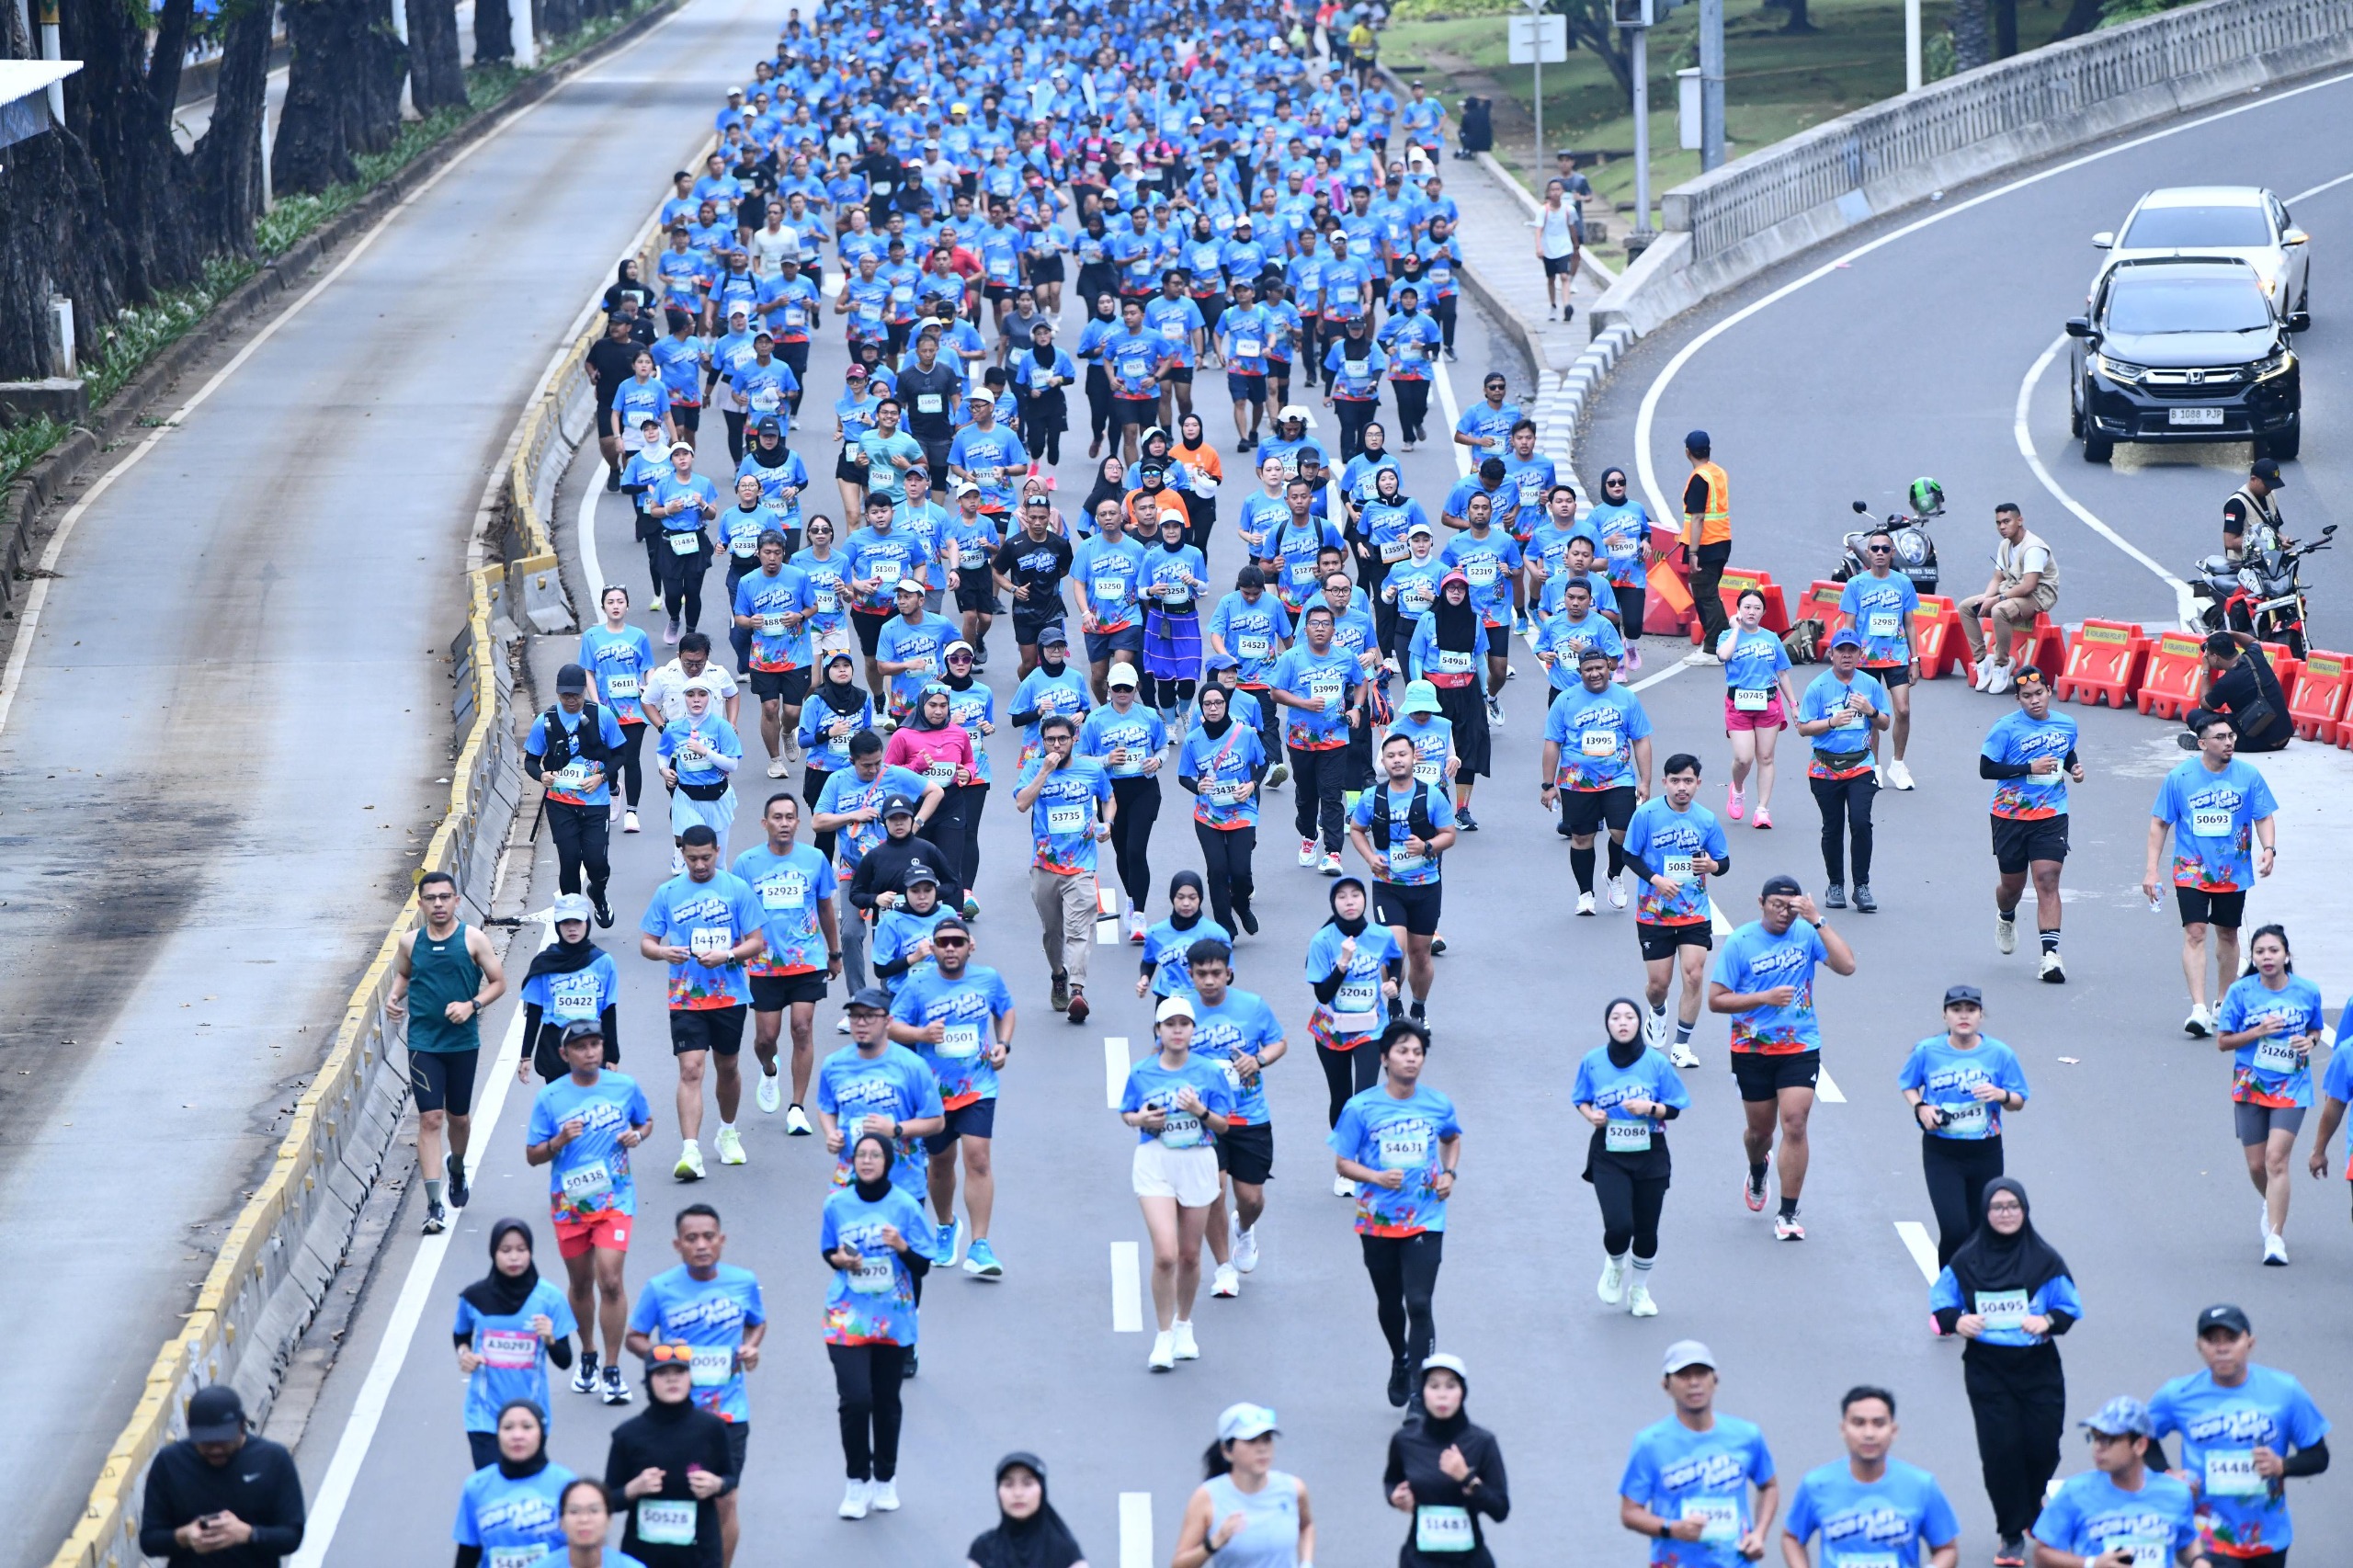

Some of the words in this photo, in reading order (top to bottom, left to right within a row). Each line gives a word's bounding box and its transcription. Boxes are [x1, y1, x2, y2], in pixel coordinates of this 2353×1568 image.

[2171, 409, 2177, 419] B
[2180, 409, 2201, 419] 1088
[2206, 409, 2222, 419] PJP
[1384, 545, 1404, 554] 13559
[874, 564, 897, 573] 51301
[1294, 566, 1313, 574] 5327
[1470, 567, 1492, 575] 52319
[1872, 618, 1896, 626] 52987
[1241, 641, 1266, 649] 54523
[1442, 656, 1468, 665] 54981
[611, 679, 634, 688] 56111
[1313, 685, 1339, 693] 53999
[1586, 736, 1612, 744] 13995
[925, 768, 952, 777] 50350
[1213, 785, 1236, 796] 3438
[1051, 812, 1080, 822] 53735
[2196, 815, 2229, 824] 50693
[1667, 862, 1690, 871] 5083
[767, 886, 799, 896] 52923
[694, 934, 728, 947] 14479
[1339, 987, 1373, 997] 52043
[558, 996, 592, 1006] 50422
[945, 1032, 973, 1043] 0501
[2261, 1045, 2295, 1059] 51268
[1950, 1108, 1982, 1119] 0543
[1609, 1127, 1646, 1137] 52086
[1385, 1142, 1422, 1153] 54631
[566, 1169, 605, 1189] 50438
[1980, 1300, 2025, 1313] 50495
[691, 1356, 727, 1367] 0059
[2210, 1460, 2255, 1472] 5448
